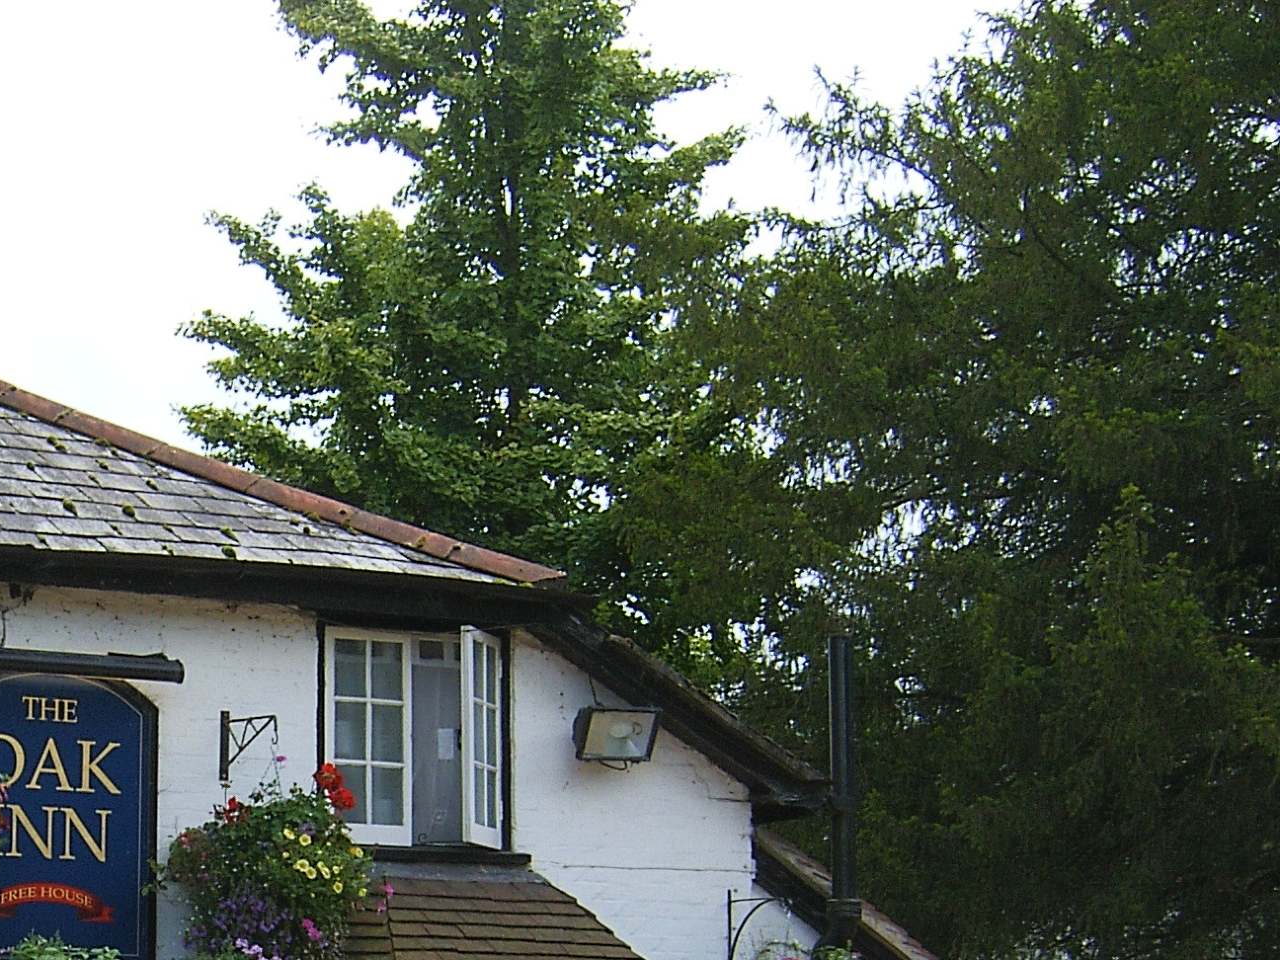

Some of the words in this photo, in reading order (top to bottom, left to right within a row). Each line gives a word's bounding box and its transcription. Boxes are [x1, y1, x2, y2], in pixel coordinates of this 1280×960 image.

[22, 696, 78, 724] THE
[0, 886, 37, 905] FREE
[40, 887, 94, 908] HOUSE
